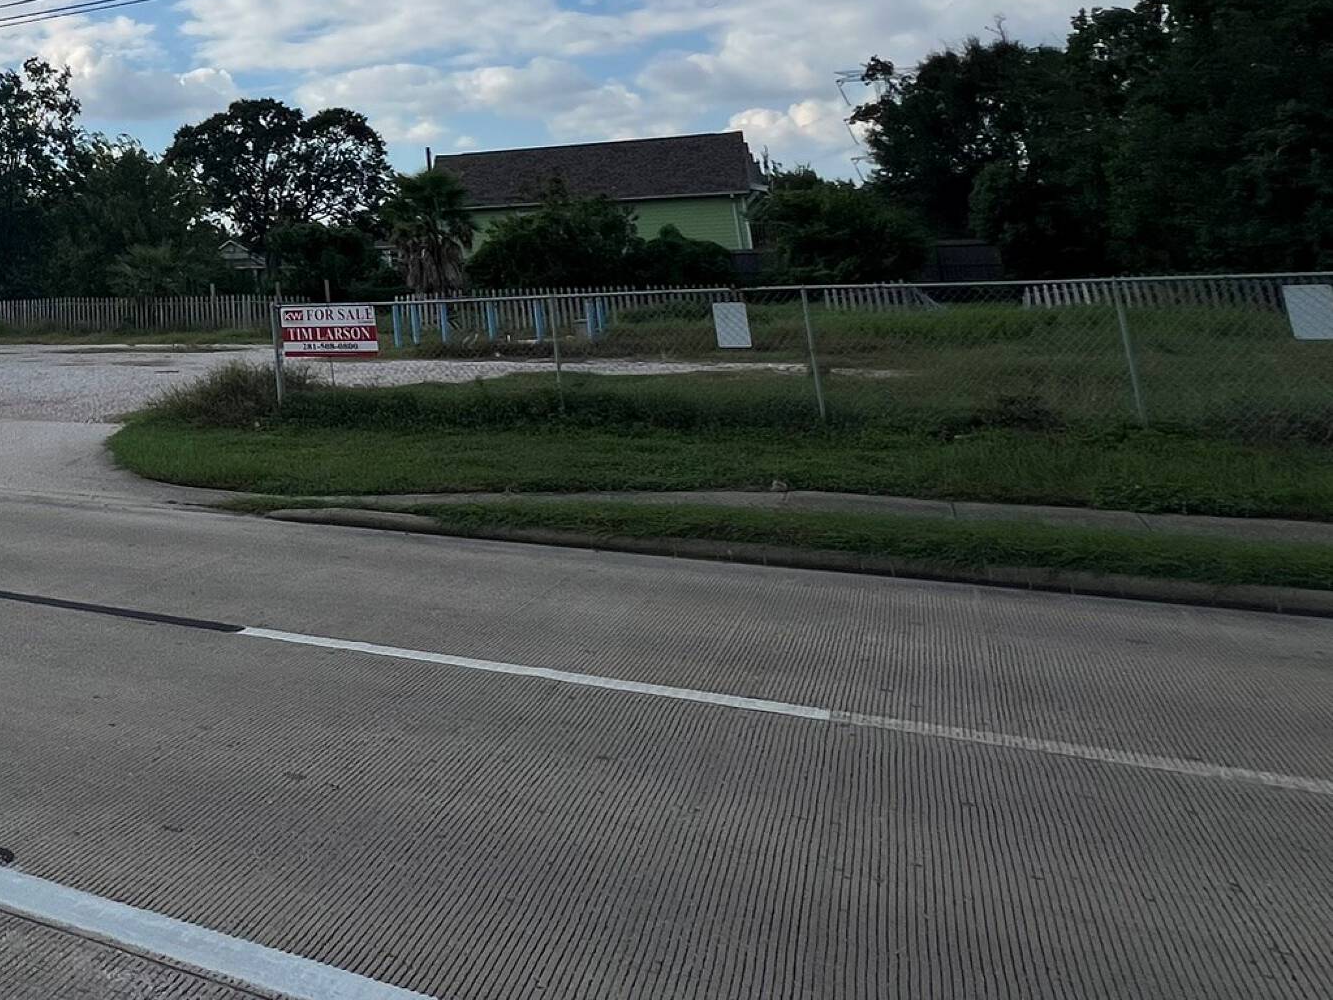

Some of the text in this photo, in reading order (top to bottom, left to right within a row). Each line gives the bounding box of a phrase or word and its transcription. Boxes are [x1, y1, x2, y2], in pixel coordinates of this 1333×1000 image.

[306, 309, 334, 321] FOR
[337, 308, 373, 321] SALE
[287, 327, 371, 341] TIM LARSON
